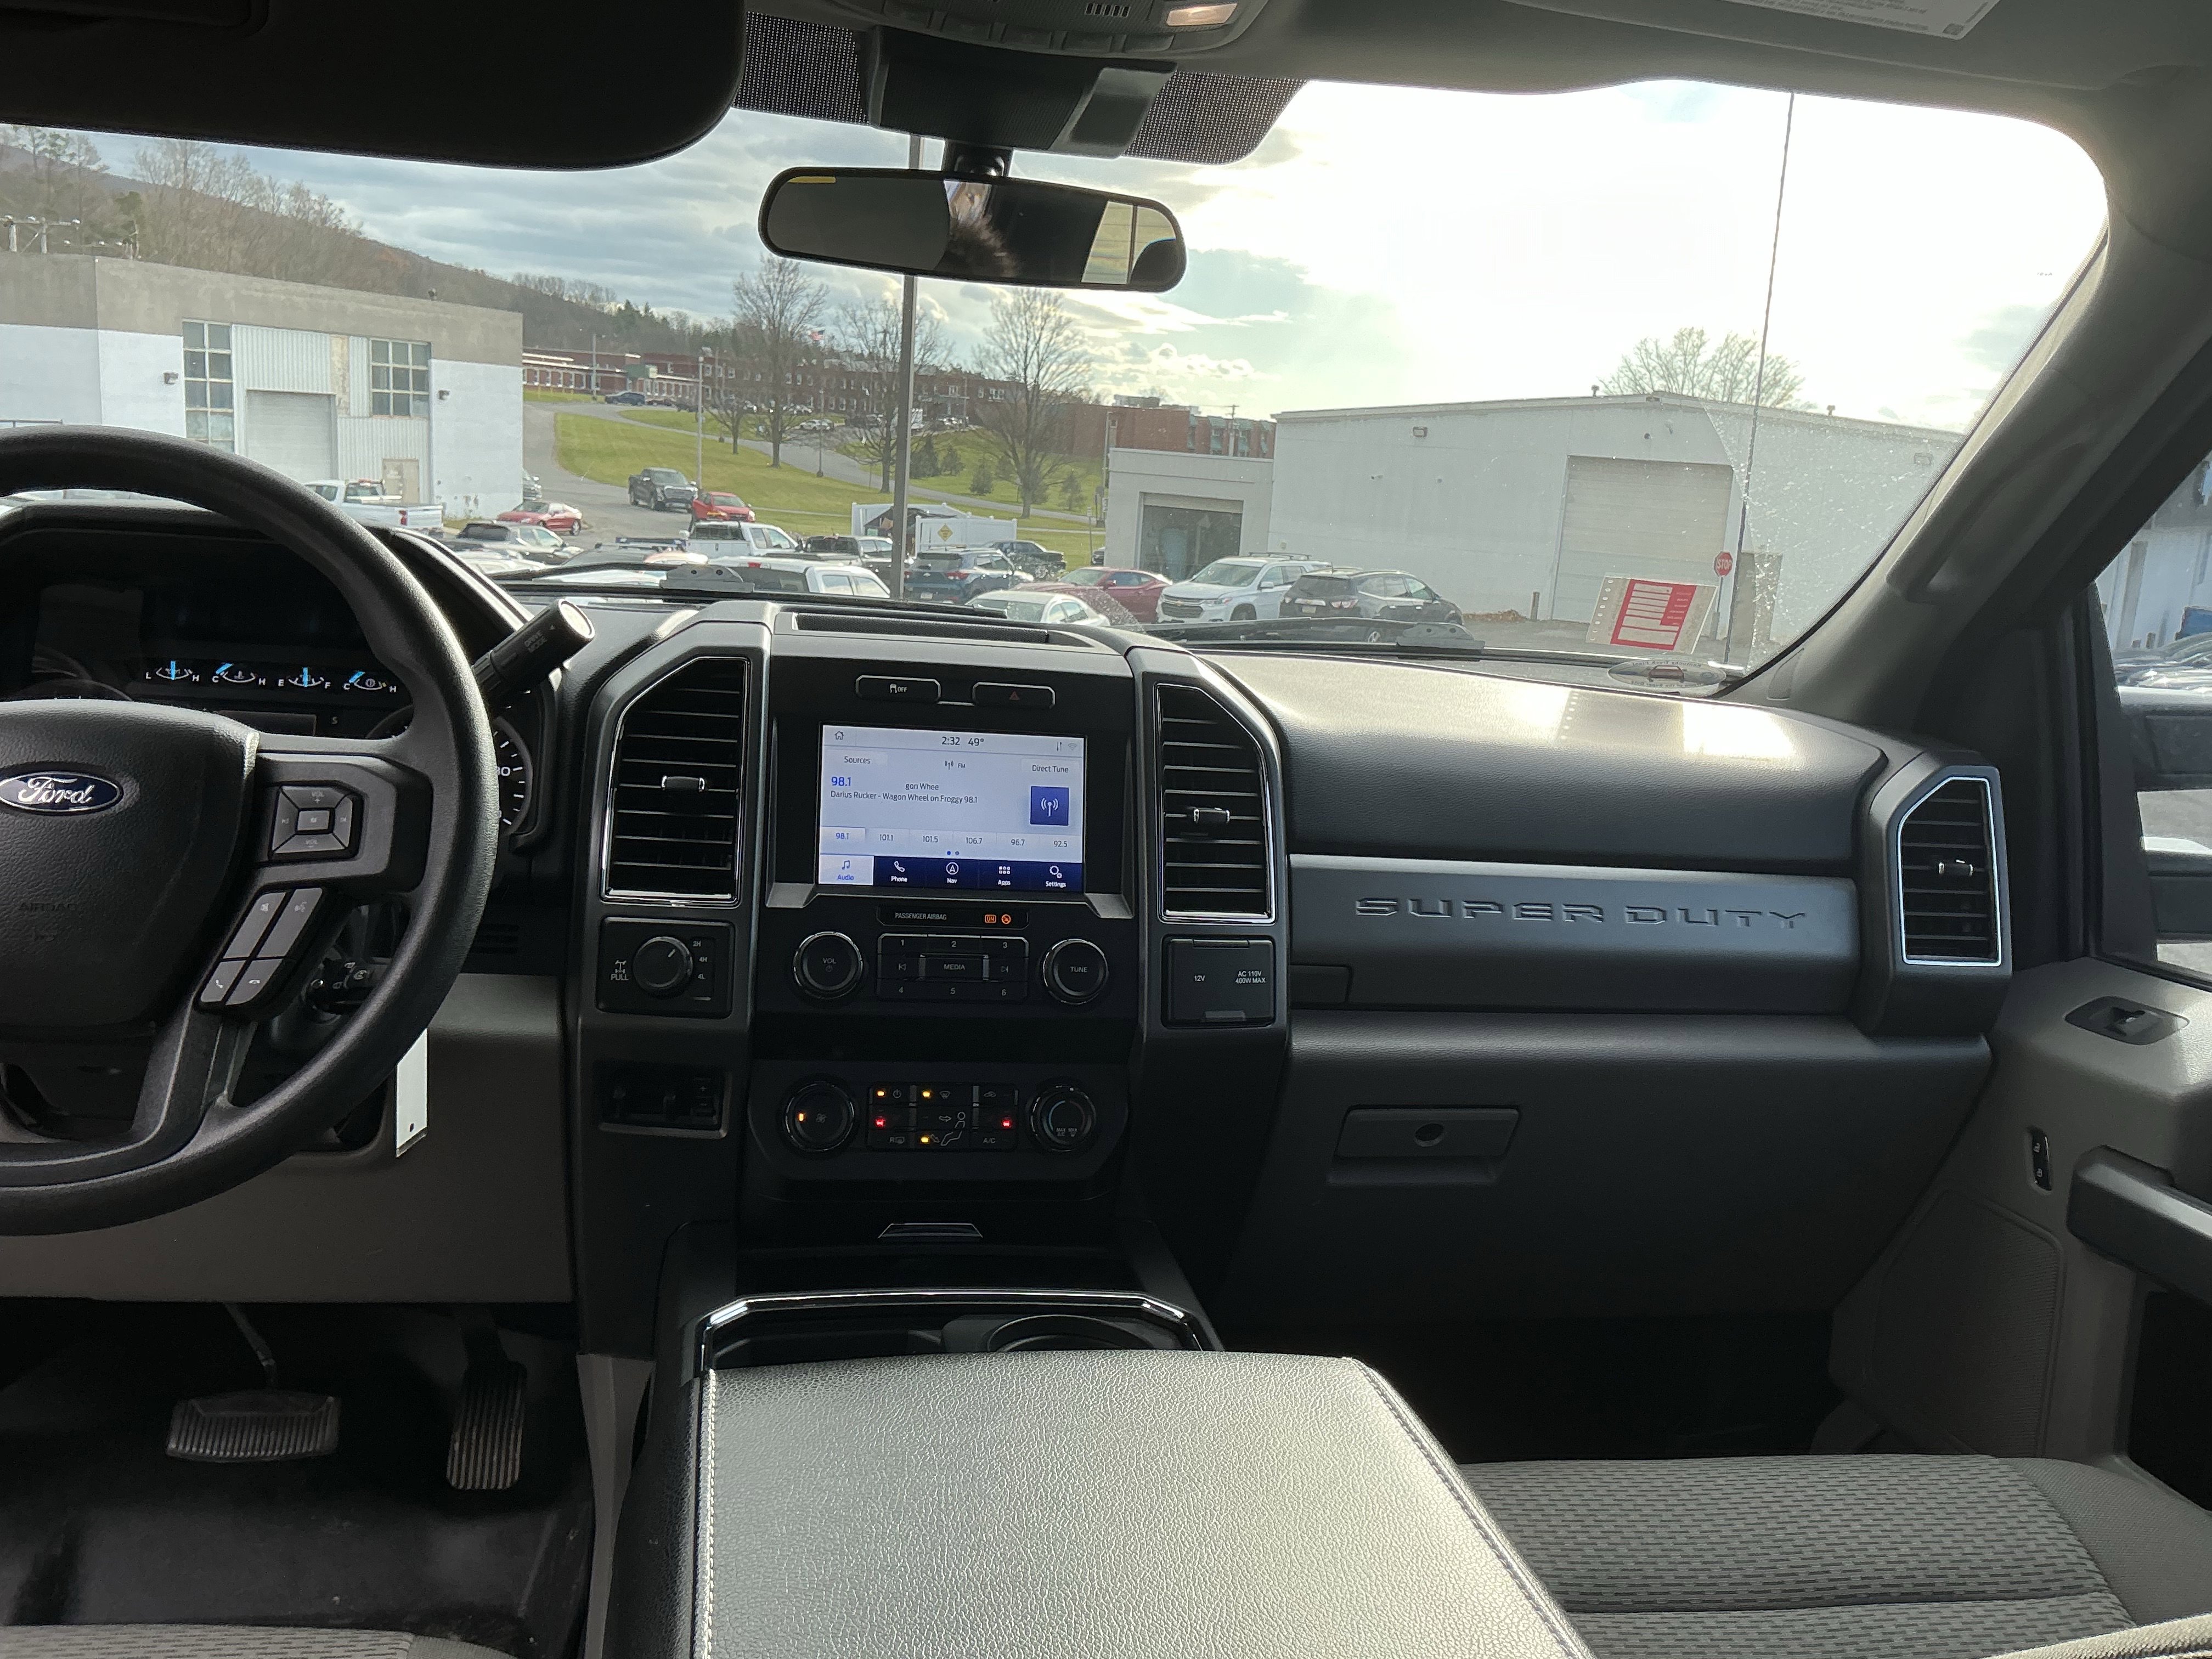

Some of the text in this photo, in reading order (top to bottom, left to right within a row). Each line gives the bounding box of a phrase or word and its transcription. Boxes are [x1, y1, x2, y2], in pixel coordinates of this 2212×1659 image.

[1716, 558, 1732, 570] STOP
[942, 736, 960, 746] 2:32
[844, 756, 871, 764] Sources
[1032, 764, 1051, 772] Direct
[831, 776, 851, 787] 98.1
[18, 776, 95, 804] Ford
[831, 790, 852, 799] Darius
[854, 791, 877, 799] Rucker
[882, 792, 906, 801] Wagon
[907, 793, 929, 802] Wheel
[940, 795, 962, 804] Froggy
[1356, 897, 1805, 929] SUPER DUTY
